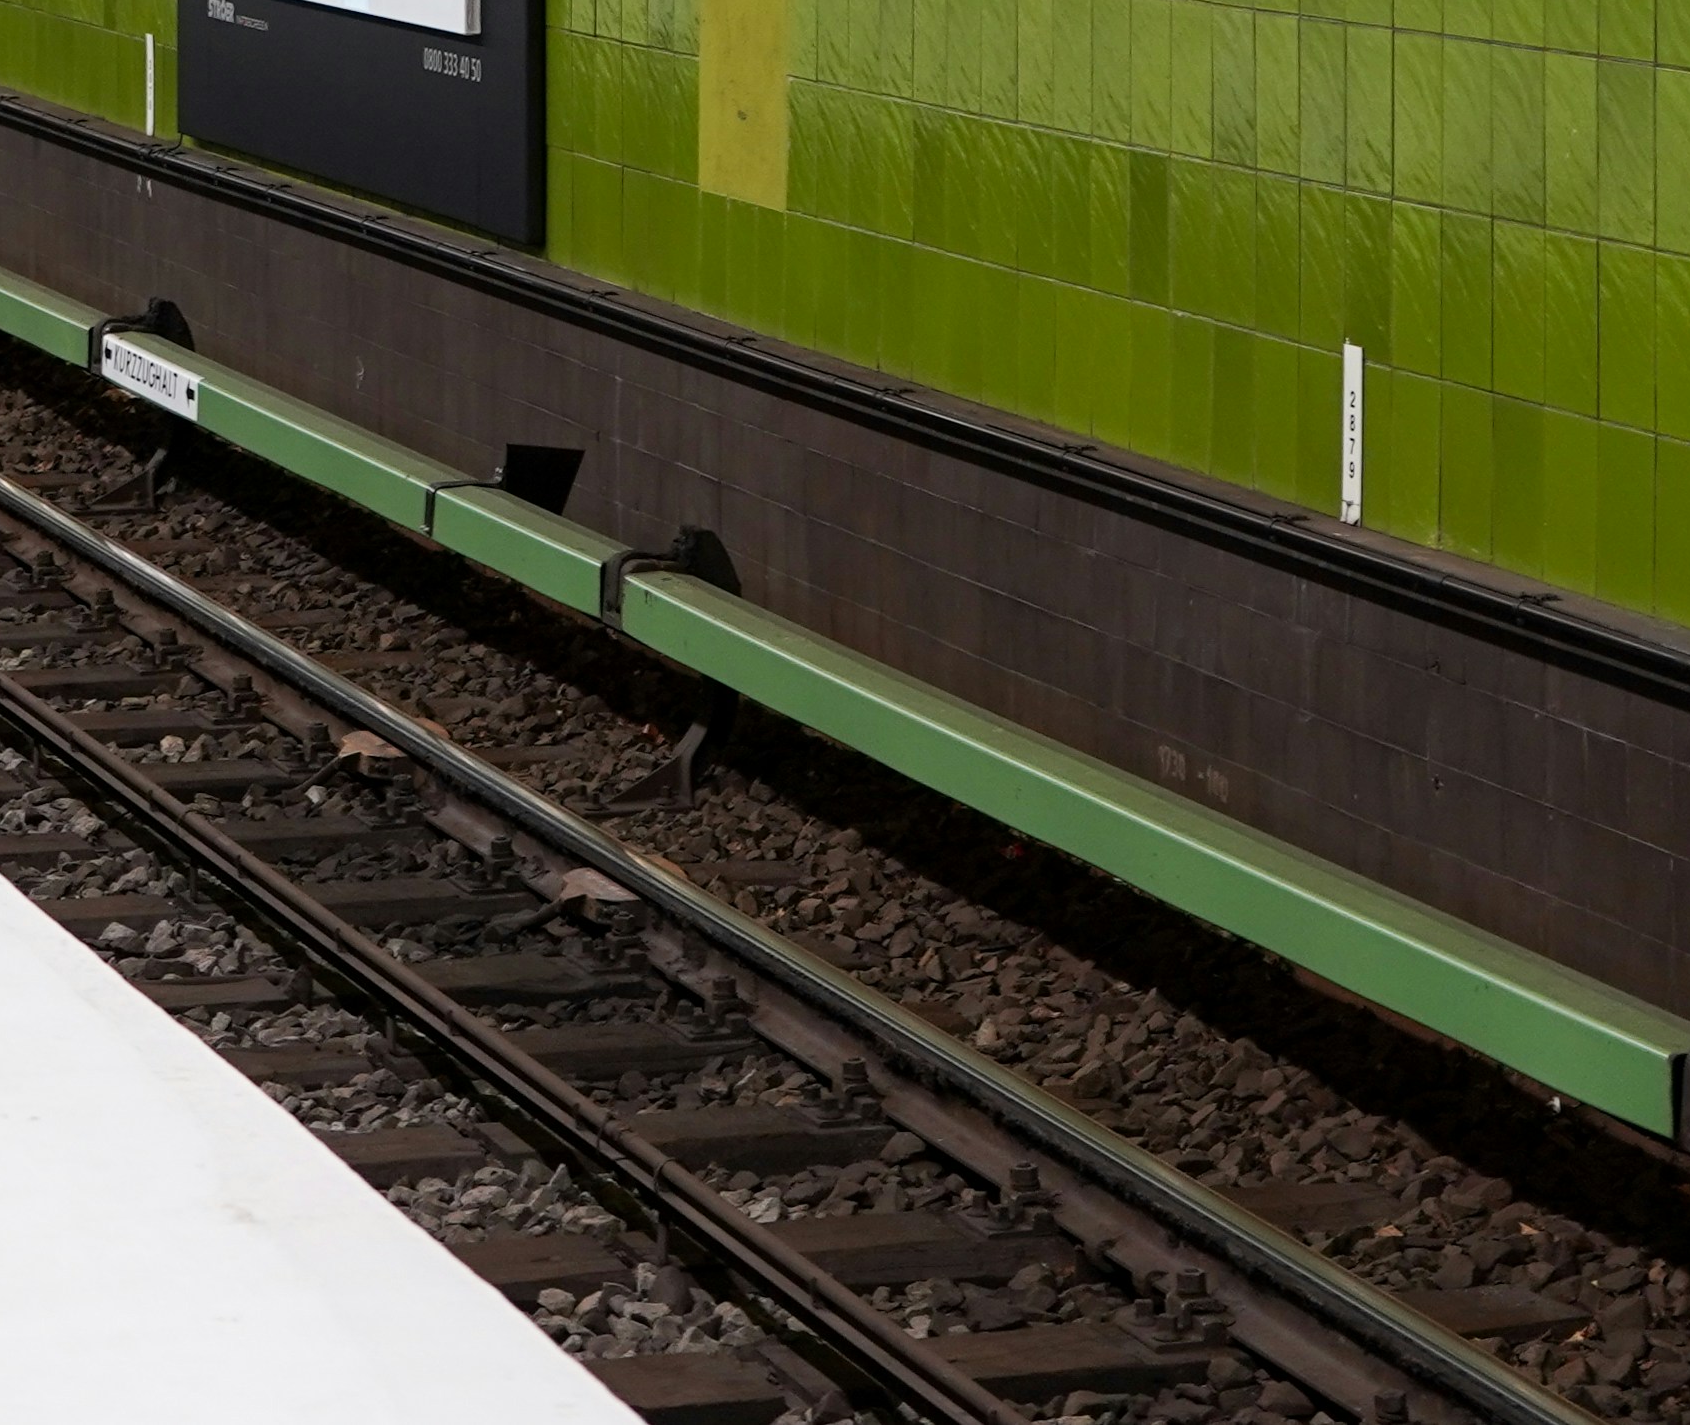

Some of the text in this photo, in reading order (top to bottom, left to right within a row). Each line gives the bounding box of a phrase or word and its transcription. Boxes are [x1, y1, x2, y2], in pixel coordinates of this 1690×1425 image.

[423, 46, 482, 83] 0800 333 40 50
[113, 343, 178, 400] KURZZUGHALT
